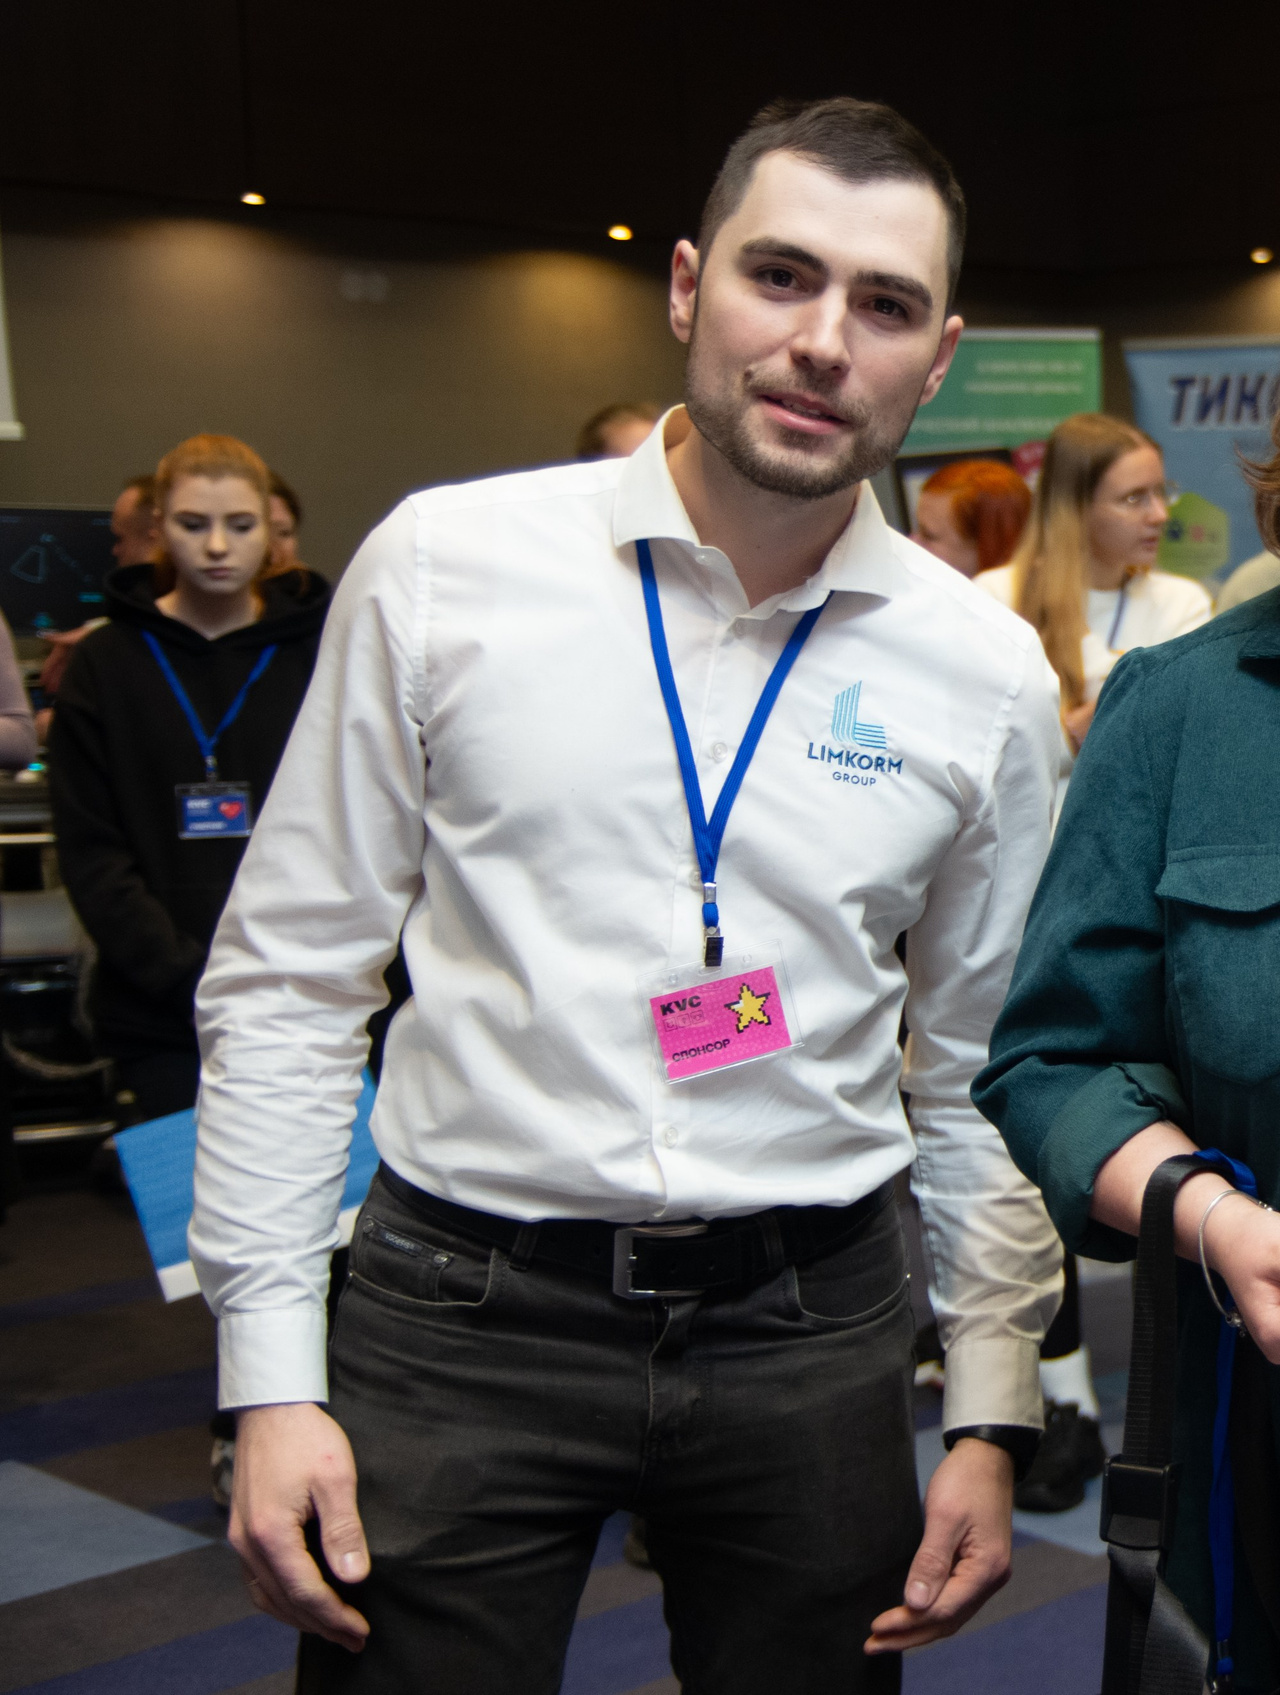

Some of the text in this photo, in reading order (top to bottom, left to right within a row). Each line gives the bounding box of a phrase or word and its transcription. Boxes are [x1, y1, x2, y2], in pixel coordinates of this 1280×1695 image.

[807, 742, 904, 775] LIMKORM
[832, 771, 877, 786] GROUP
[660, 995, 703, 1017] KVC
[672, 1038, 730, 1062] СПОНСОР
